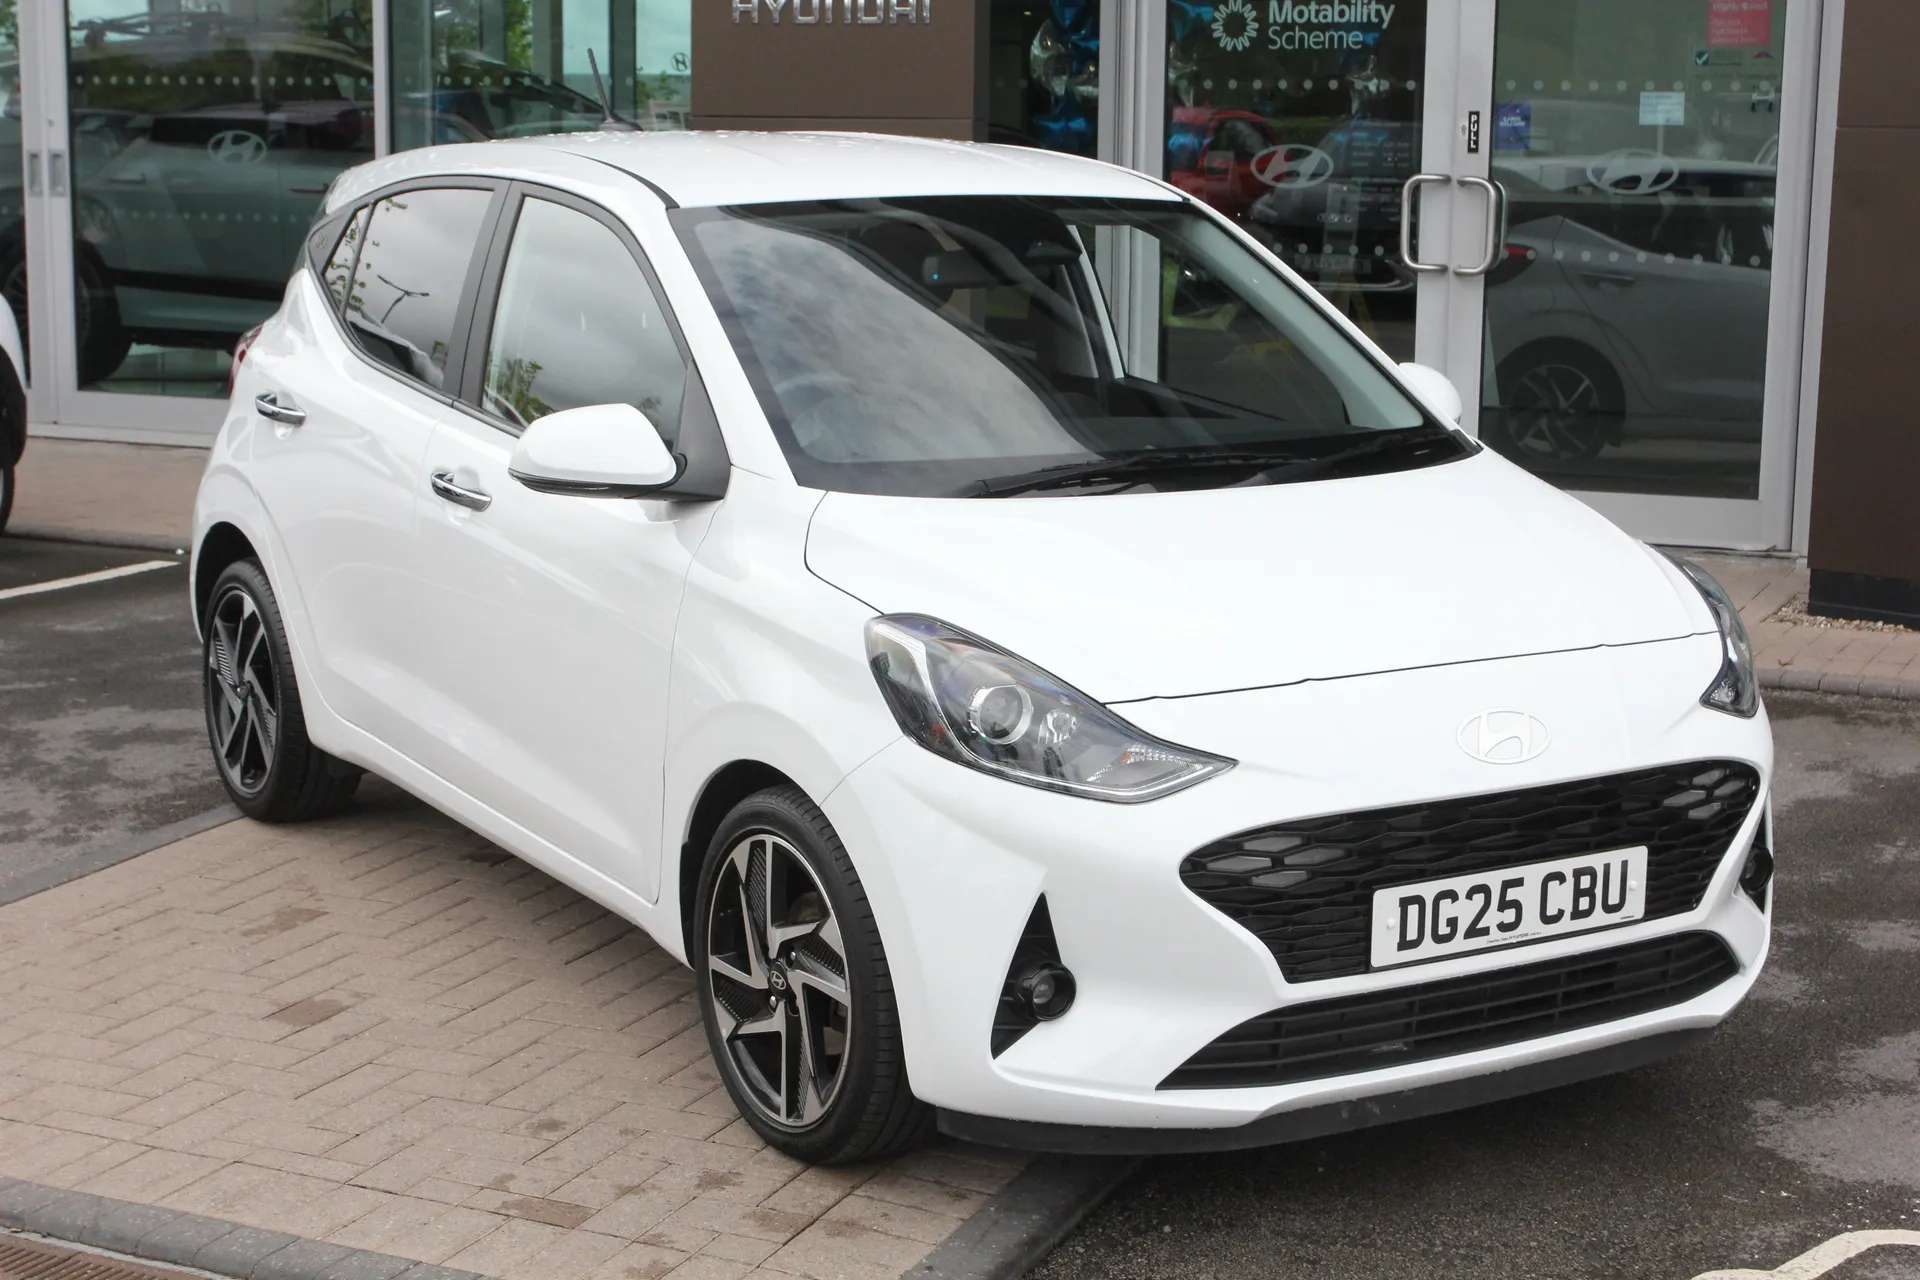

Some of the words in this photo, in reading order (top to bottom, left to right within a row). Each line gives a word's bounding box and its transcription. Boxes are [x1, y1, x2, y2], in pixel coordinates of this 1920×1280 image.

[732, 0, 930, 24] HYUNDAI
[1268, 0, 1396, 29] Motability
[1268, 25, 1363, 49] Scheme
[1470, 114, 1478, 149] PULL
[1397, 876, 1525, 952] DG25
[1539, 859, 1629, 926] CBU
